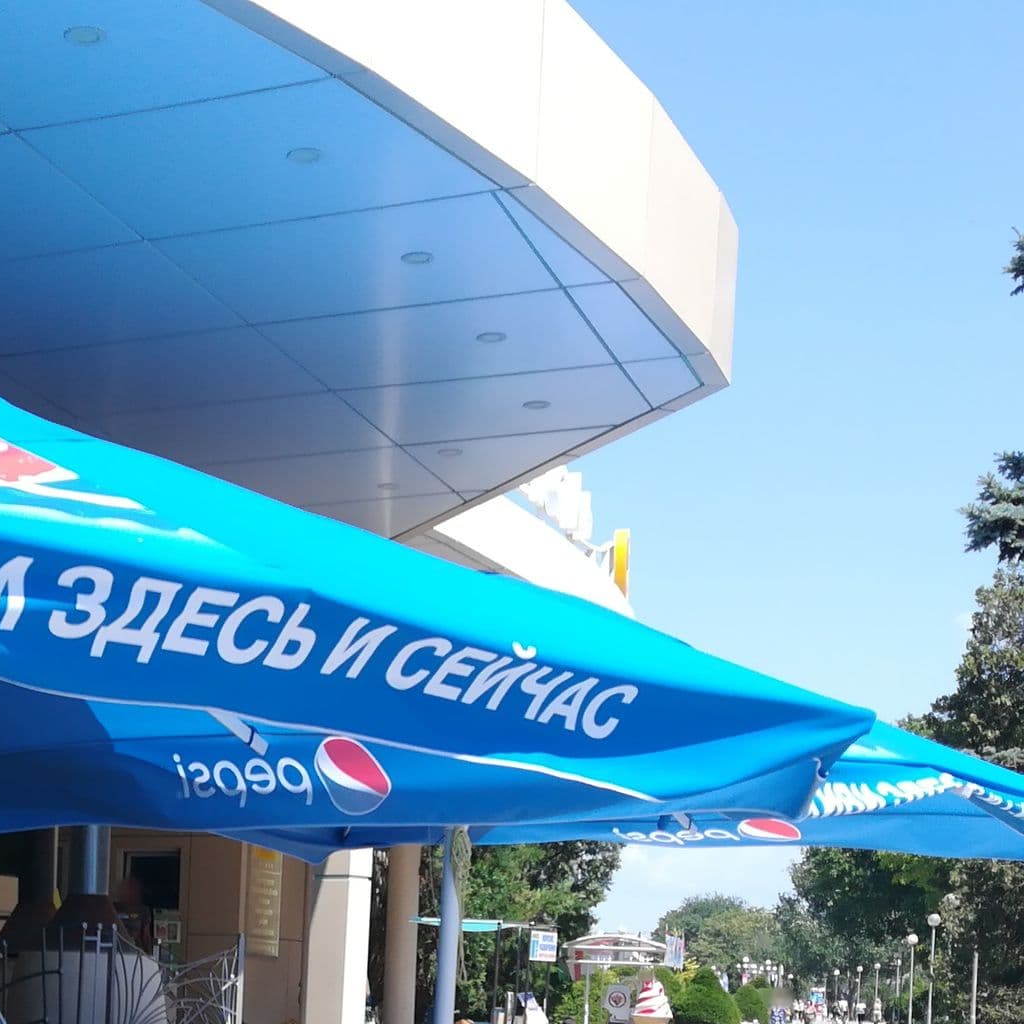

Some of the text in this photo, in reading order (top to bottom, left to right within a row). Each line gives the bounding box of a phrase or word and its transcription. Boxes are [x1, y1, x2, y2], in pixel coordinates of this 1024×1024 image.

[48, 565, 317, 669] ЗДЕСЬ
[324, 615, 398, 681] И
[385, 641, 639, 741] СЕЙЧАС
